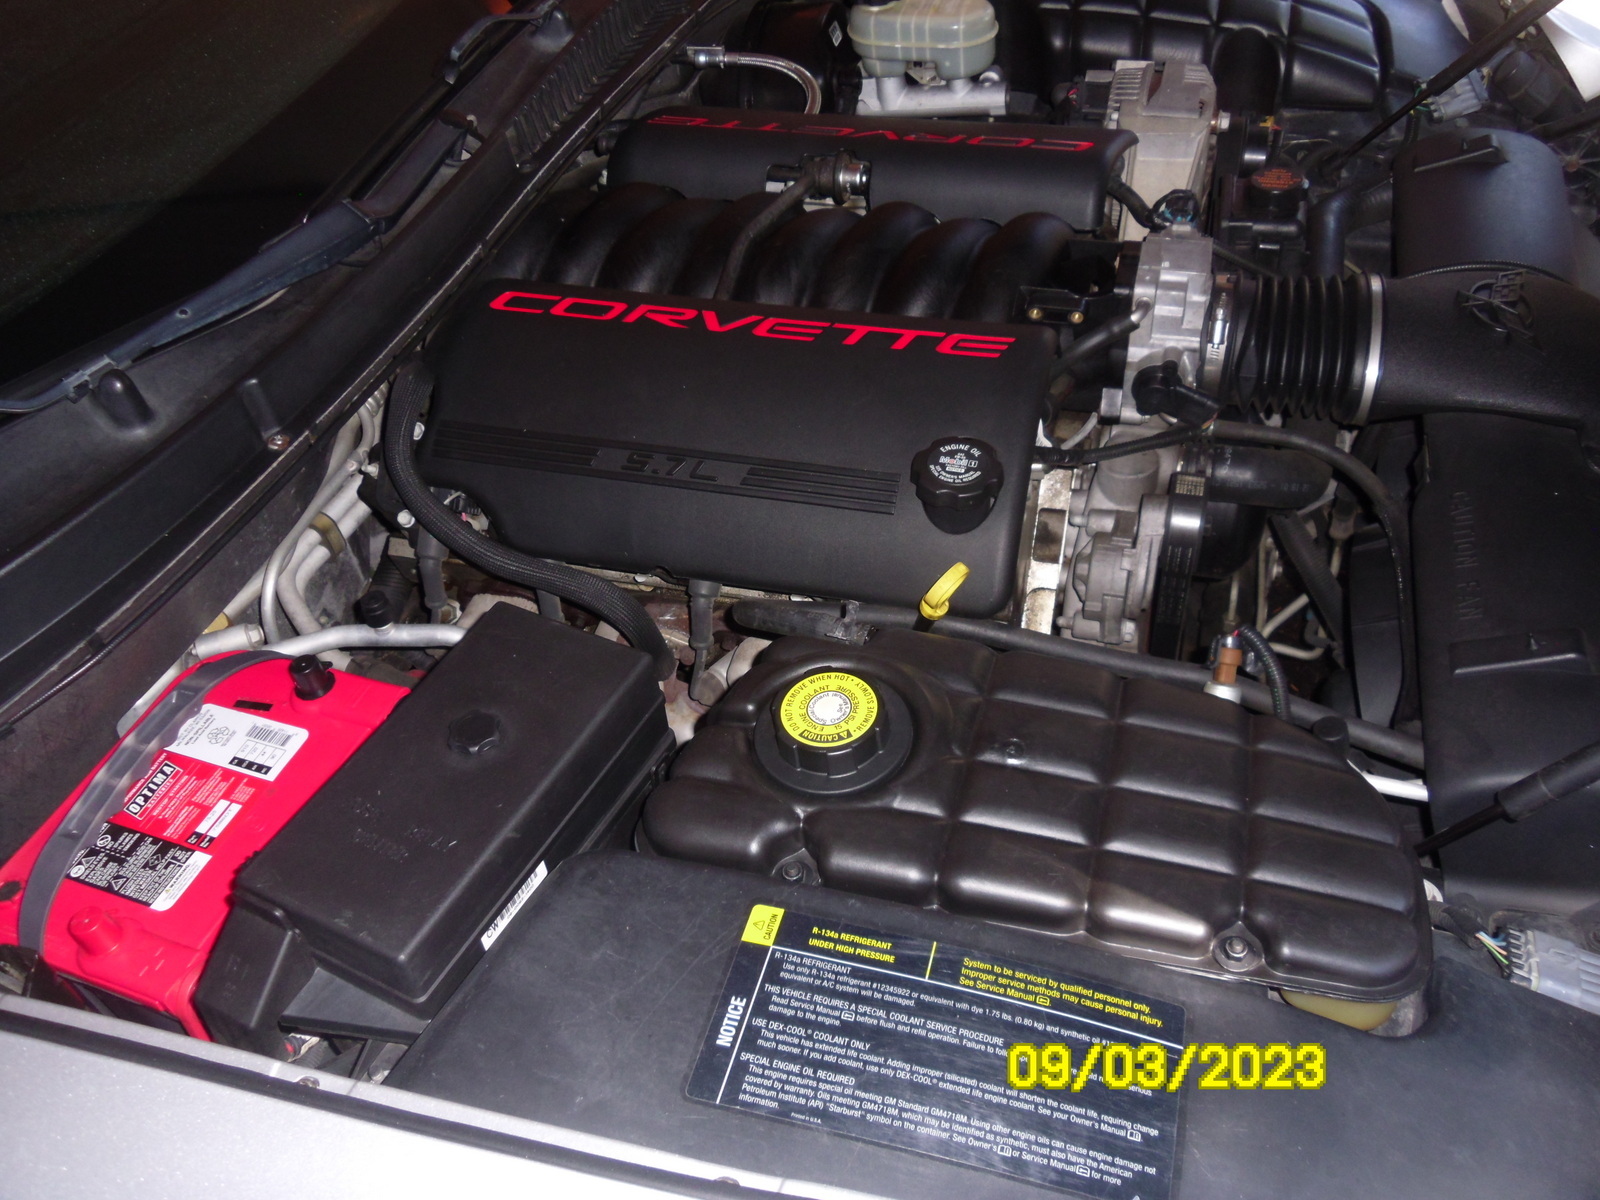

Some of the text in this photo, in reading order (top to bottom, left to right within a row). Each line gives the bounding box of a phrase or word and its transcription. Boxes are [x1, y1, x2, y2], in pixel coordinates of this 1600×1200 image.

[648, 115, 1095, 152] CORVETTE
[490, 291, 1016, 358] CORVETTE
[940, 444, 970, 452] ENGINE
[970, 448, 981, 457] OIL
[620, 452, 718, 482] 5.7L
[1450, 492, 1482, 620] CAUTION FAN
[808, 674, 832, 684] WHEN
[786, 683, 807, 706] REMOVE
[799, 685, 830, 731] ENGINE COOLANT
[836, 685, 859, 713] PRESSURE
[855, 682, 874, 731] REMOVE SLOWLY
[785, 709, 793, 722] NOT
[790, 723, 800, 732] DO
[844, 715, 856, 725] PSI
[802, 731, 838, 741] CAUTION
[127, 764, 174, 814] OPTIMA
[486, 921, 499, 938] CW
[763, 914, 778, 940] CAUTION
[812, 926, 892, 949] R-134a REFRIGERANT
[774, 951, 851, 973] R-134a REFRIGERANT
[808, 938, 895, 962] UNDER HIGH PRESSURE
[779, 971, 813, 983] equivalent
[821, 979, 834, 988] A/C
[835, 983, 859, 994] system
[883, 994, 915, 1006] damaged.
[959, 976, 1035, 1001] See Service Manual
[961, 966, 1162, 1028] Improper service methods may cause personal injury.
[963, 957, 1150, 1013] System to be serviced by qualified personnel only.
[716, 996, 747, 1047] NOTICE
[764, 983, 780, 993] THIS
[782, 987, 811, 1000] VEHICLE
[812, 994, 849, 1009] REQUIRES
[857, 1004, 886, 1018] SPECIAL
[889, 1011, 924, 1026] COOLANT
[925, 1020, 957, 1034] SERVICE
[958, 1028, 1004, 1046] PROCEDURE
[768, 1004, 795, 1016] damage
[805, 1011, 816, 1020] the
[817, 1015, 841, 1026] engine.
[751, 1017, 767, 1027] USE
[813, 1031, 849, 1045] COOLANT
[850, 1039, 870, 1050] ONLY
[739, 1051, 855, 1085] SPECIAL ENGINE OIL REQUIRED
[760, 1028, 774, 1038] This
[775, 1033, 799, 1044] vehicle
[800, 1038, 813, 1047] has
[814, 1042, 846, 1054] extended
[846, 1049, 857, 1057] life
[858, 1052, 885, 1064] coolant.
[886, 1058, 910, 1072] Adding
[911, 1064, 943, 1080] improper
[944, 1072, 977, 1087] (silicated)
[978, 1081, 1004, 1094] coolant
[1018, 1092, 1045, 1104] shorten
[1046, 1098, 1058, 1107] the
[1059, 1103, 1085, 1115] coolant
[1086, 1109, 1099, 1119] life,
[1100, 1114, 1131, 1130] requiring
[1131, 1123, 1158, 1136] change
[738, 1092, 779, 1108] information.
[748, 1063, 762, 1073] This
[763, 1069, 787, 1080] engine
[788, 1075, 817, 1087] requires
[818, 1082, 843, 1092] special
[854, 1090, 882, 1103] meeting
[883, 1095, 896, 1105] GM
[897, 1099, 929, 1113] Standard
[930, 1107, 969, 1123] GM4718M.
[970, 1117, 990, 1130] Using
[991, 1124, 1010, 1133] other
[1011, 1129, 1035, 1141] engine
[1036, 1136, 1049, 1144] oils
[1050, 1139, 1064, 1148] can
[1065, 1143, 1087, 1154] cause
[1088, 1150, 1112, 1162] engine
[1113, 1156, 1142, 1171] damage
